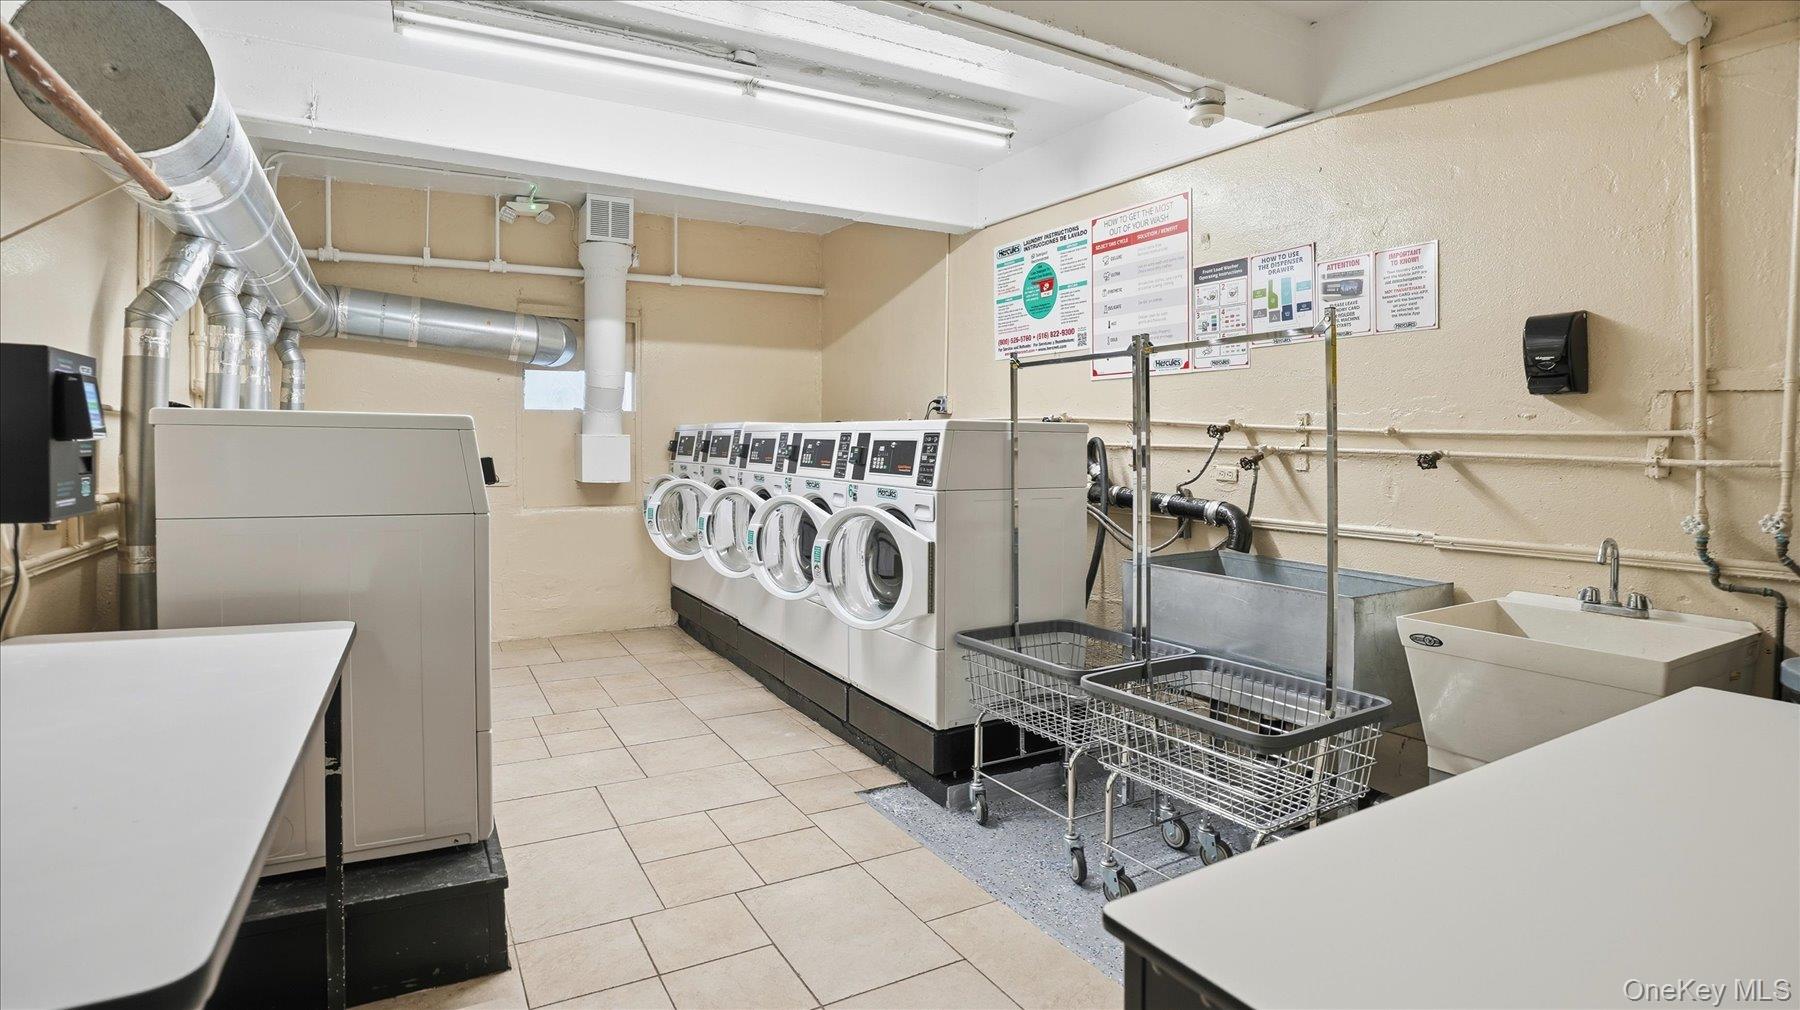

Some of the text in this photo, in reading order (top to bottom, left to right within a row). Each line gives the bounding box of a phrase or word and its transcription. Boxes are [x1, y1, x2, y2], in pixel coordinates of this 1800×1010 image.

[1104, 201, 1174, 228] HOW TO GET THE MOST
[1109, 213, 1169, 236] OUT OF YOUR WASH
[1023, 225, 1079, 247] LAUNDRY INSTRUCTIONS
[1023, 237, 1059, 252] INSTRUCCIONES
[1068, 230, 1088, 240] LAVADO
[998, 244, 1020, 258] Hercules
[1389, 249, 1421, 260] IMPORTANT
[1258, 257, 1303, 271] THE DISPENSER
[1262, 256, 1276, 264] HOW
[1327, 259, 1360, 271] ATTENTION
[1268, 266, 1294, 275] DRAWER
[1156, 358, 1181, 367] Hercules
